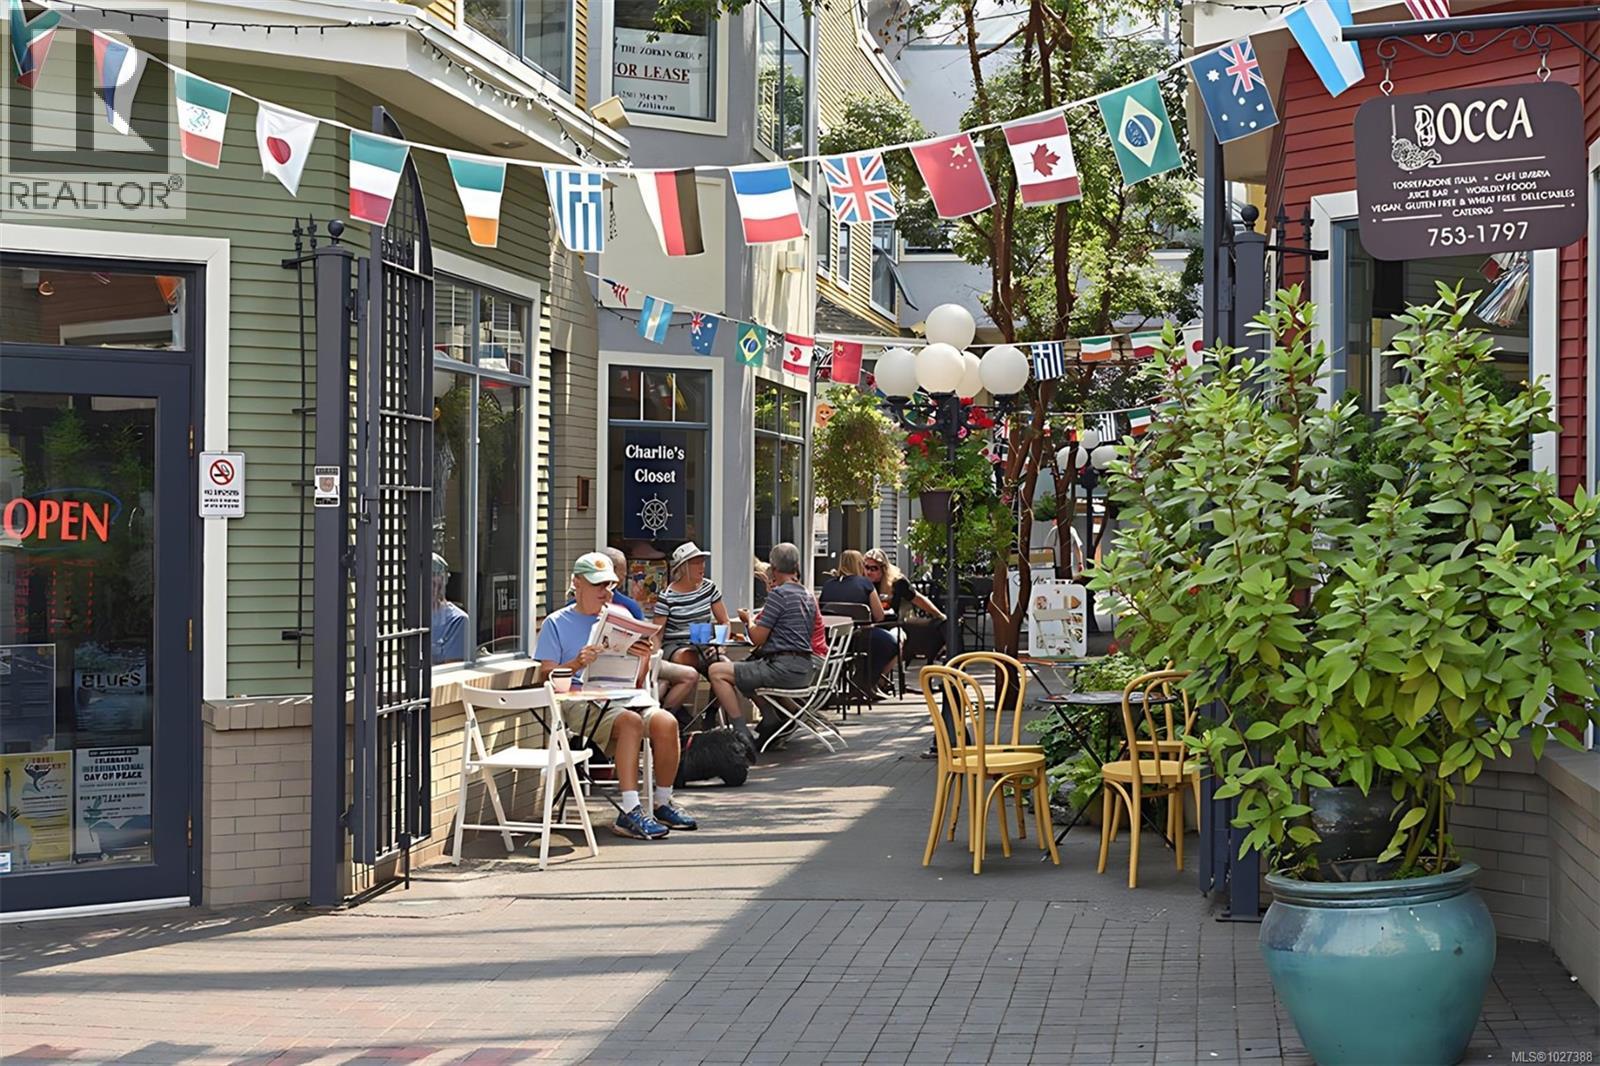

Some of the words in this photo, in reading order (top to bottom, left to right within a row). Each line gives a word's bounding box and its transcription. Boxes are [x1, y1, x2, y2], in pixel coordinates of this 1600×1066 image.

[614, 62, 637, 77] OR
[644, 65, 690, 81] LEASE
[1454, 176, 1477, 185] ITALIA
[1407, 190, 1430, 199] JUICE
[1432, 188, 1448, 197] BAR
[1465, 184, 1505, 194] WORLDLY
[1506, 181, 1537, 191] FOODS
[1405, 200, 1436, 210] GLUTEN
[1437, 198, 1456, 207] FREE
[1459, 198, 1466, 206] &
[1468, 195, 1495, 205] WHEAT
[1497, 193, 1516, 202] FREE
[1521, 189, 1575, 201] DELECTABLES
[1452, 206, 1493, 217] CATERING
[1427, 221, 1529, 247] 753-1797
[625, 444, 685, 460] Charlie's
[634, 468, 676, 483] Closet
[3, 497, 110, 542] OPEN
[84, 773, 101, 782] DAY
[102, 772, 114, 780] OF
